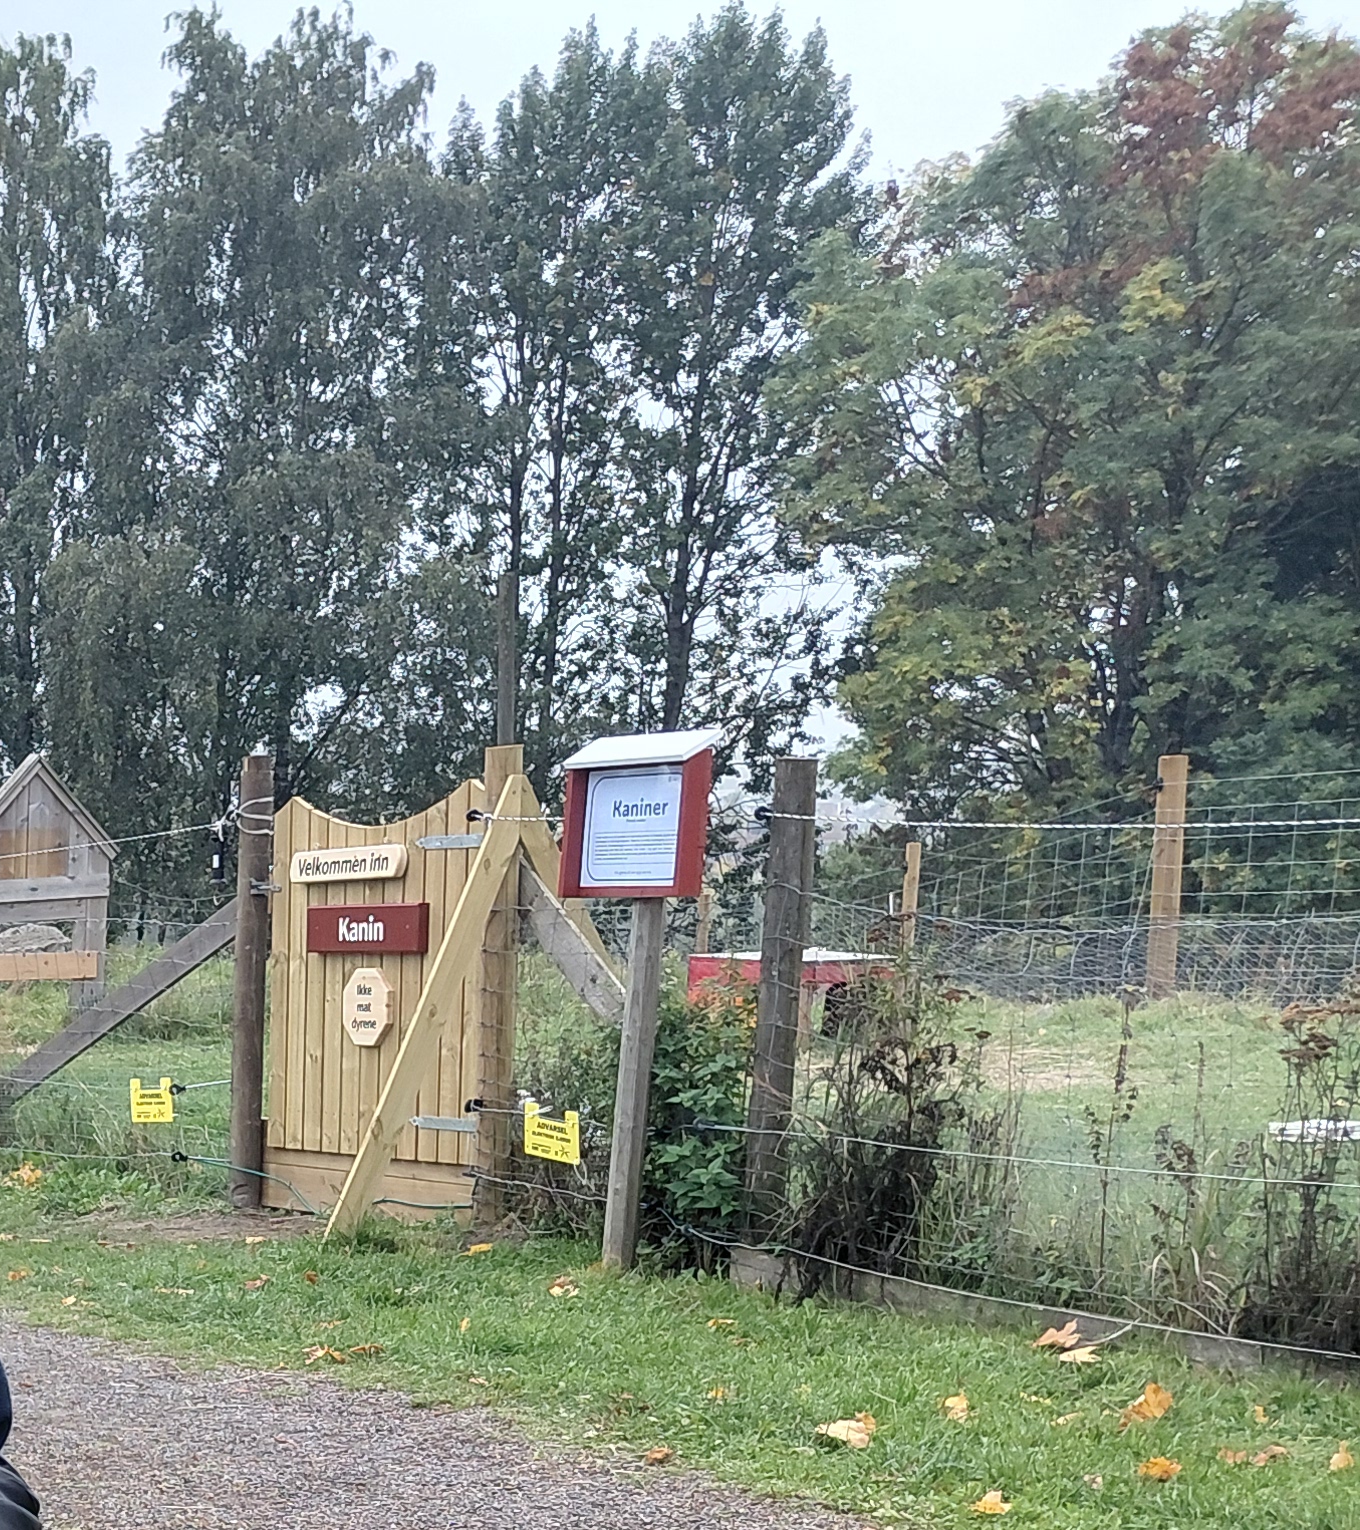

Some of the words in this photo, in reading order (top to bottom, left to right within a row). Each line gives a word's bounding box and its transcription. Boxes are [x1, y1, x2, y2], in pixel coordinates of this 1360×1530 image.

[612, 797, 669, 818] Kaniner
[298, 856, 367, 877] Velkommen
[369, 852, 389, 872] inn
[338, 914, 384, 942] Kanin
[357, 984, 372, 996] Ikke
[357, 1002, 371, 1012] mat
[351, 1016, 377, 1032] dyrene
